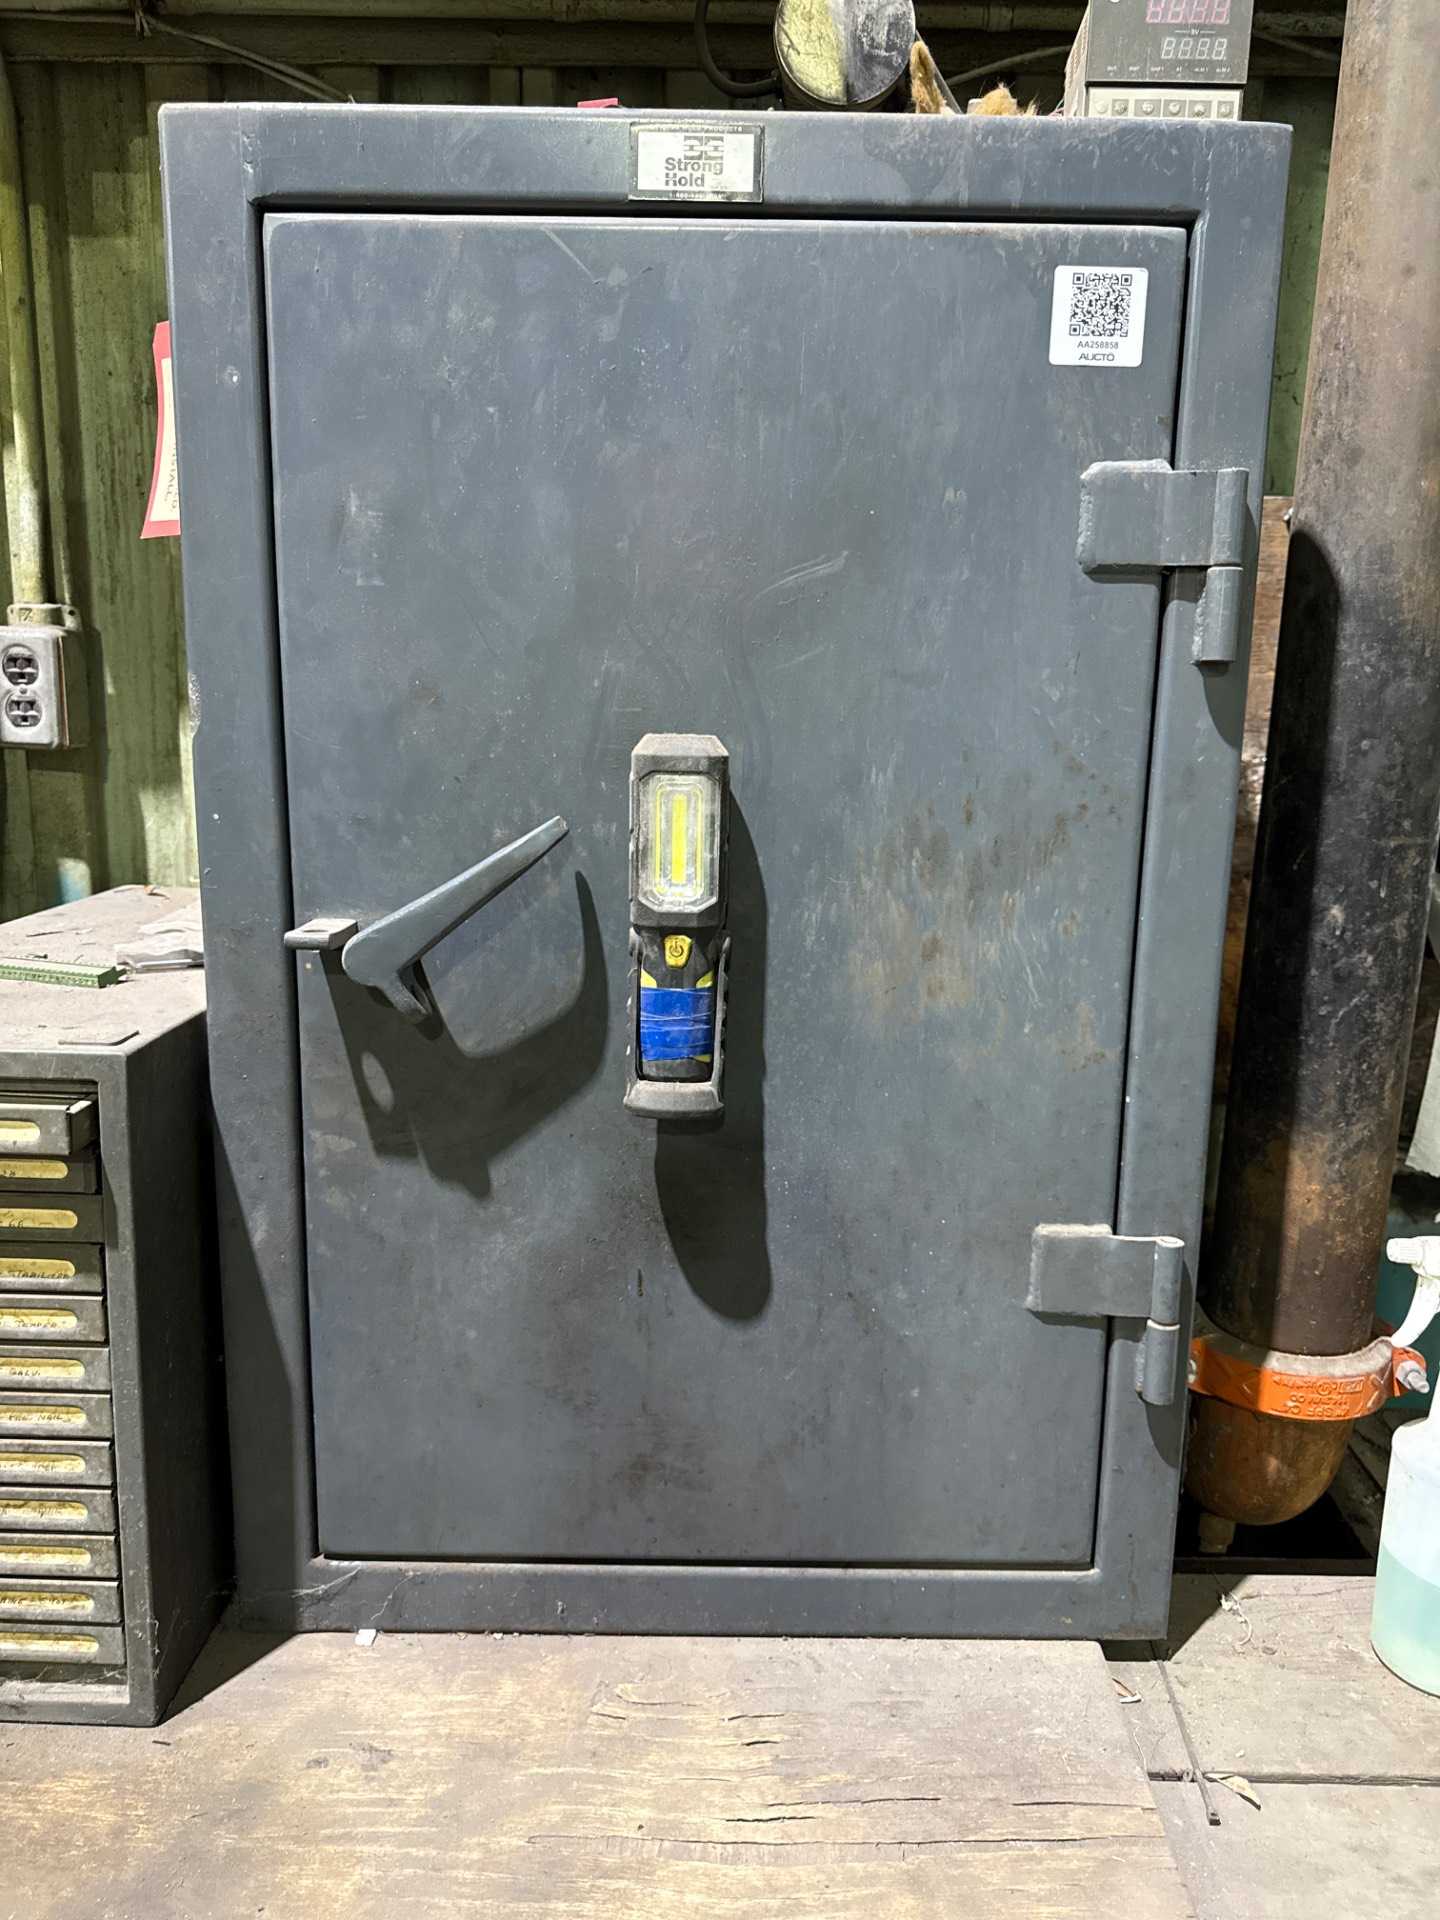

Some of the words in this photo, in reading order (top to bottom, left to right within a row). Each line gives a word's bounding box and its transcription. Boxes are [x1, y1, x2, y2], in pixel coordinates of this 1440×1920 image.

[664, 157, 724, 176] Strong
[664, 173, 705, 187] Hold
[1078, 353, 1115, 361] AUCTO
